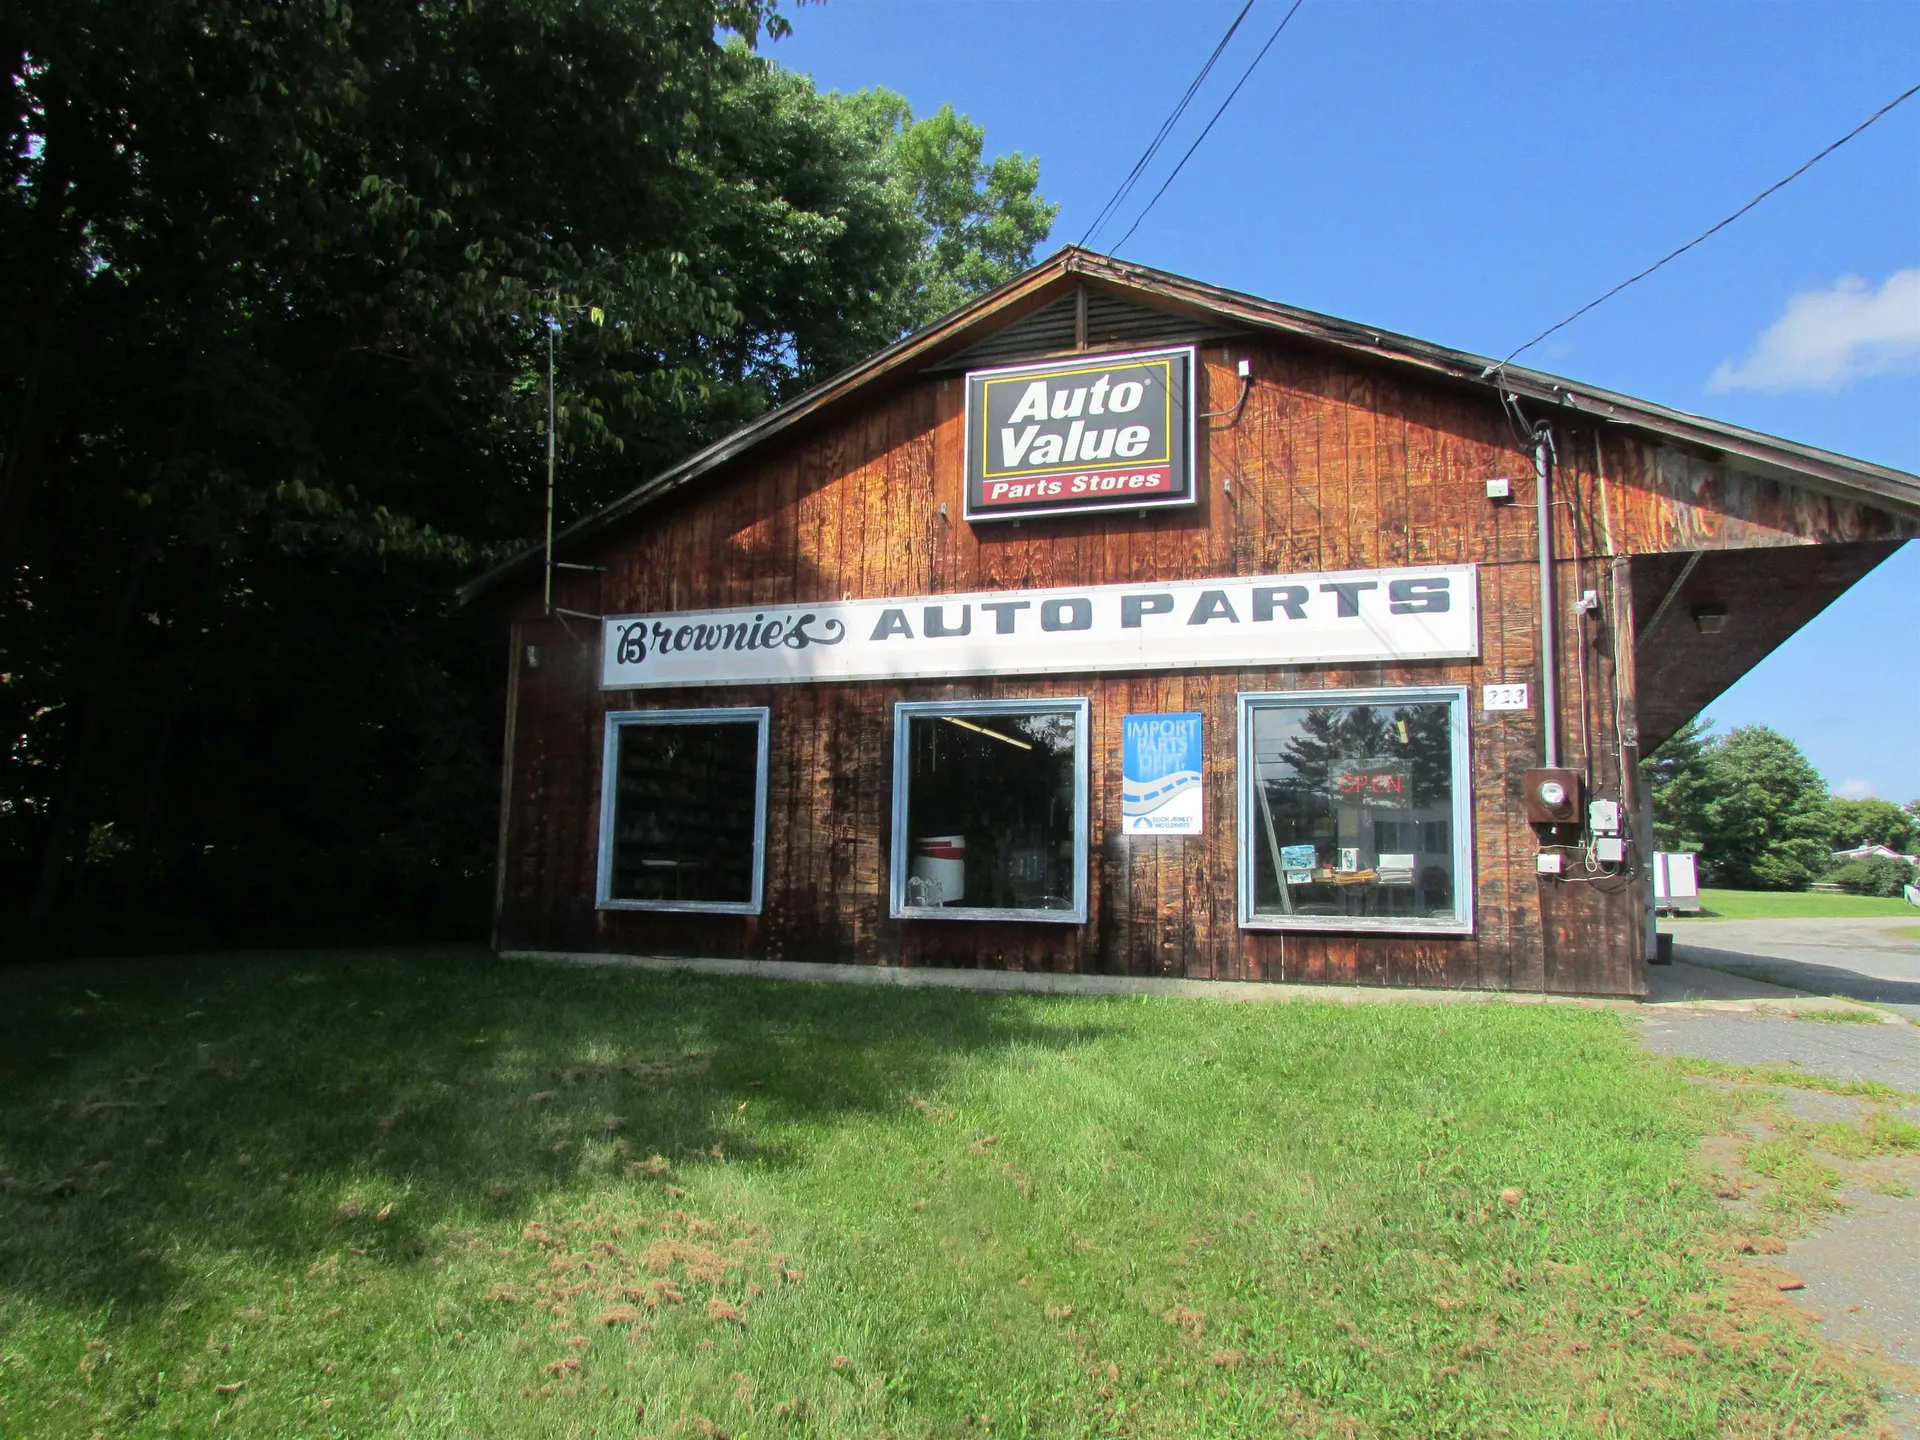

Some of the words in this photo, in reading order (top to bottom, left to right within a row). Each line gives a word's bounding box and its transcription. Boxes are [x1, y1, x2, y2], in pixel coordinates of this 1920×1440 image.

[1008, 374, 1144, 424] Auto
[1001, 420, 1151, 468] Value
[990, 479, 1062, 500] Parts
[1071, 472, 1161, 493] Stores
[617, 613, 846, 665] Brownie's
[869, 597, 1093, 641] AUTO
[1121, 577, 1450, 629] PARTS
[1485, 688, 1526, 705] 223
[1127, 719, 1197, 738] IMPORT
[1137, 736, 1188, 754] PARTS
[1338, 773, 1403, 793] OPEN
